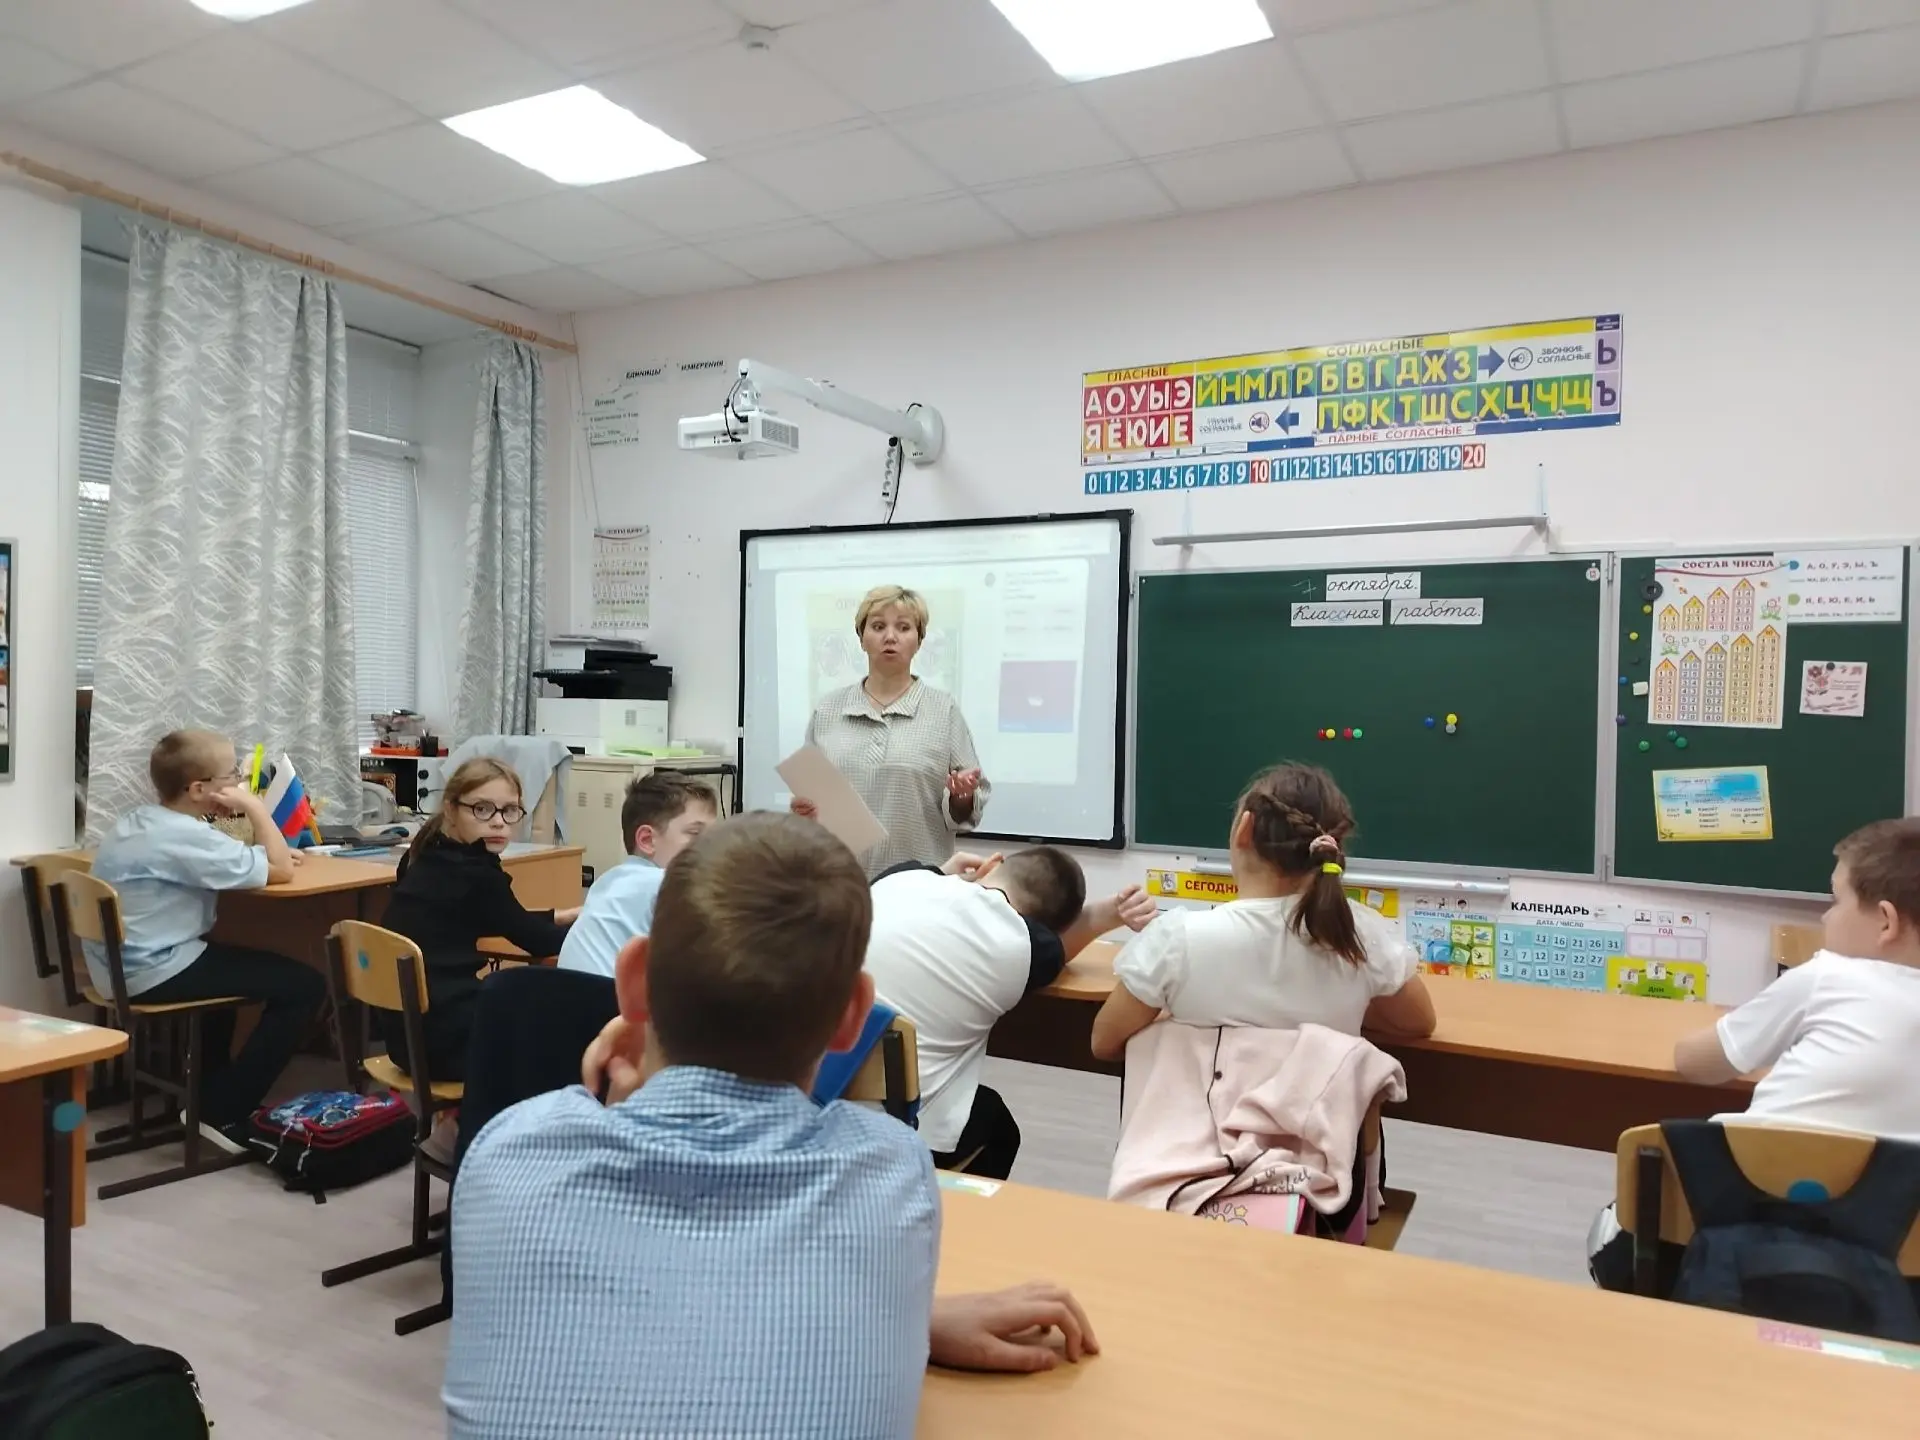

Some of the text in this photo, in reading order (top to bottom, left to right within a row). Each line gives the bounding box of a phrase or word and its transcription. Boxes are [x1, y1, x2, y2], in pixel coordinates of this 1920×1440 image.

[1327, 338, 1424, 357] СОГЛАСНЫЕ
[1542, 345, 1583, 355] ЗВОНКИЕ
[1537, 353, 1592, 364] СОГЛАСНЫЕ
[626, 360, 724, 379] ЕДИНИЦЫ ИЗМЕРЕНИЯ
[1107, 368, 1169, 382] ГЛАСНЫЕ
[1328, 426, 1462, 443] ПАРНЫЕ СОГЛАСНЫЕ
[1088, 445, 1484, 493] 0 1 2 3 4 5 6 7 8 9 10 11 12 13 14 15 16 17 18 19 20
[1682, 559, 1774, 569] СОСТАВ ЧИСЛА
[1293, 604, 1380, 620] Классная
[1511, 902, 1589, 915] КАЛЕНДАРЬ
[1554, 937, 1565, 945] 16
[1572, 939, 1582, 947] 21
[1608, 940, 1618, 948] 31
